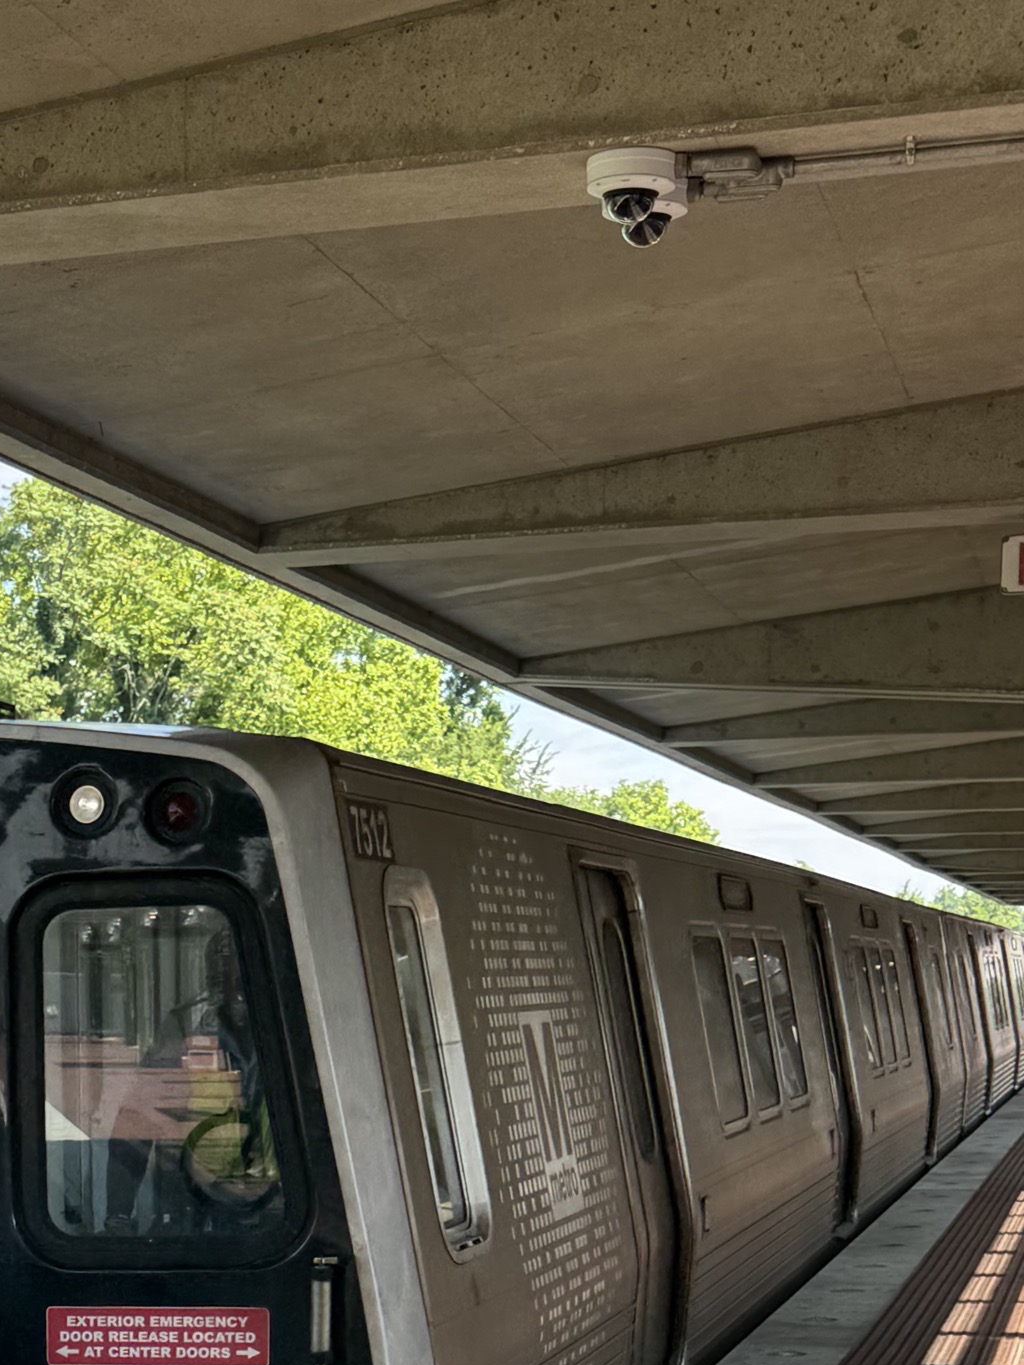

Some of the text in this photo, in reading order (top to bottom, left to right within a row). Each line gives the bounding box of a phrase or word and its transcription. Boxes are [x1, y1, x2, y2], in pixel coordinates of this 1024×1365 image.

[349, 805, 393, 858] 7512
[550, 1162, 579, 1204] metro
[66, 1315, 248, 1328] EXTERIOR EMERGENCY
[59, 1331, 256, 1344] DOOR RELEASE LOCATED
[84, 1346, 231, 1359] AT CENTER DOORS
